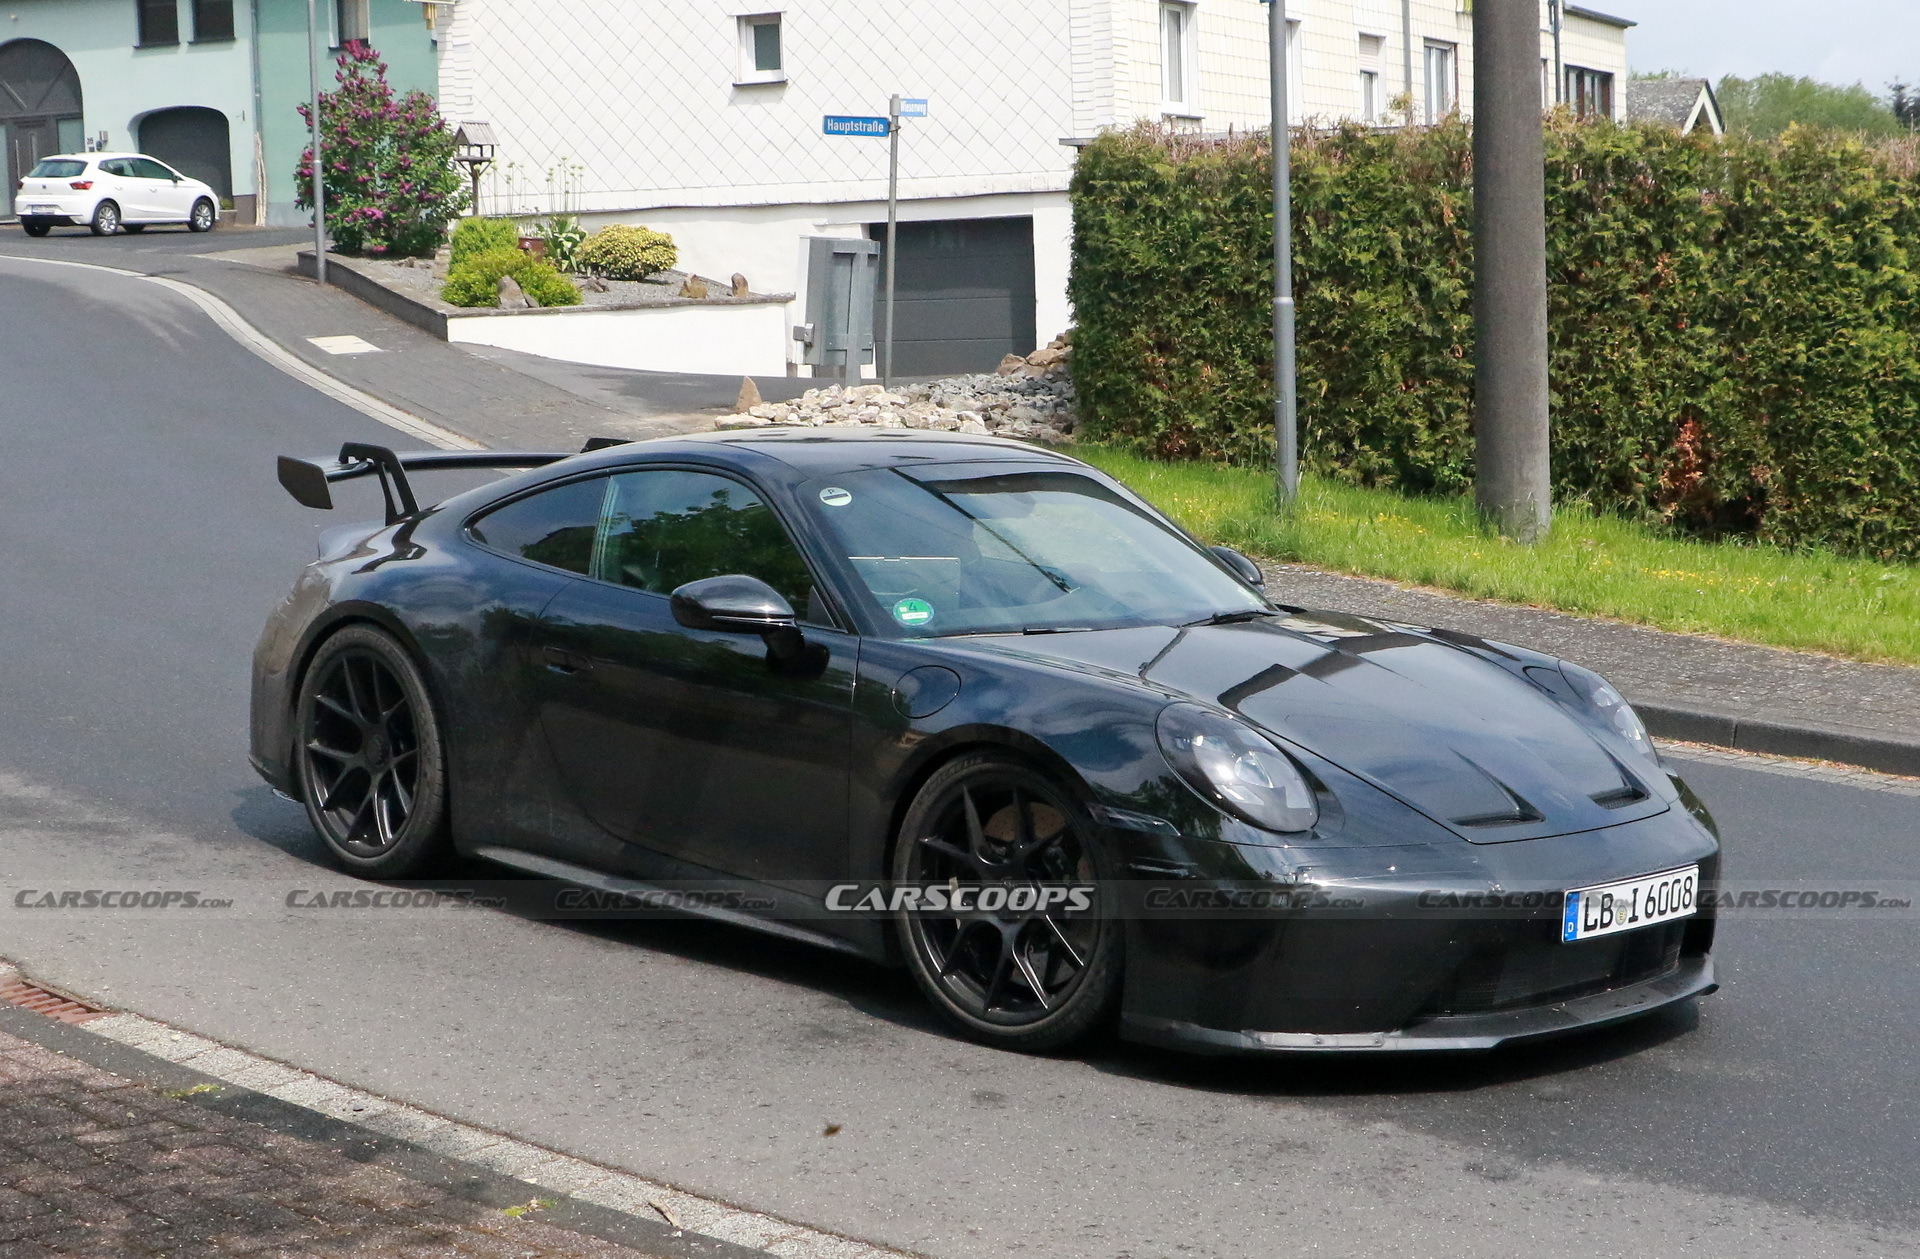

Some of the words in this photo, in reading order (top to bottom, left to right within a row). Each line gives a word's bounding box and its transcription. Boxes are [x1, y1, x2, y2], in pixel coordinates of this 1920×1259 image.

[827, 118, 884, 134] Hauptstraße
[1645, 875, 1693, 919] 6008
[1567, 922, 1574, 933] D
